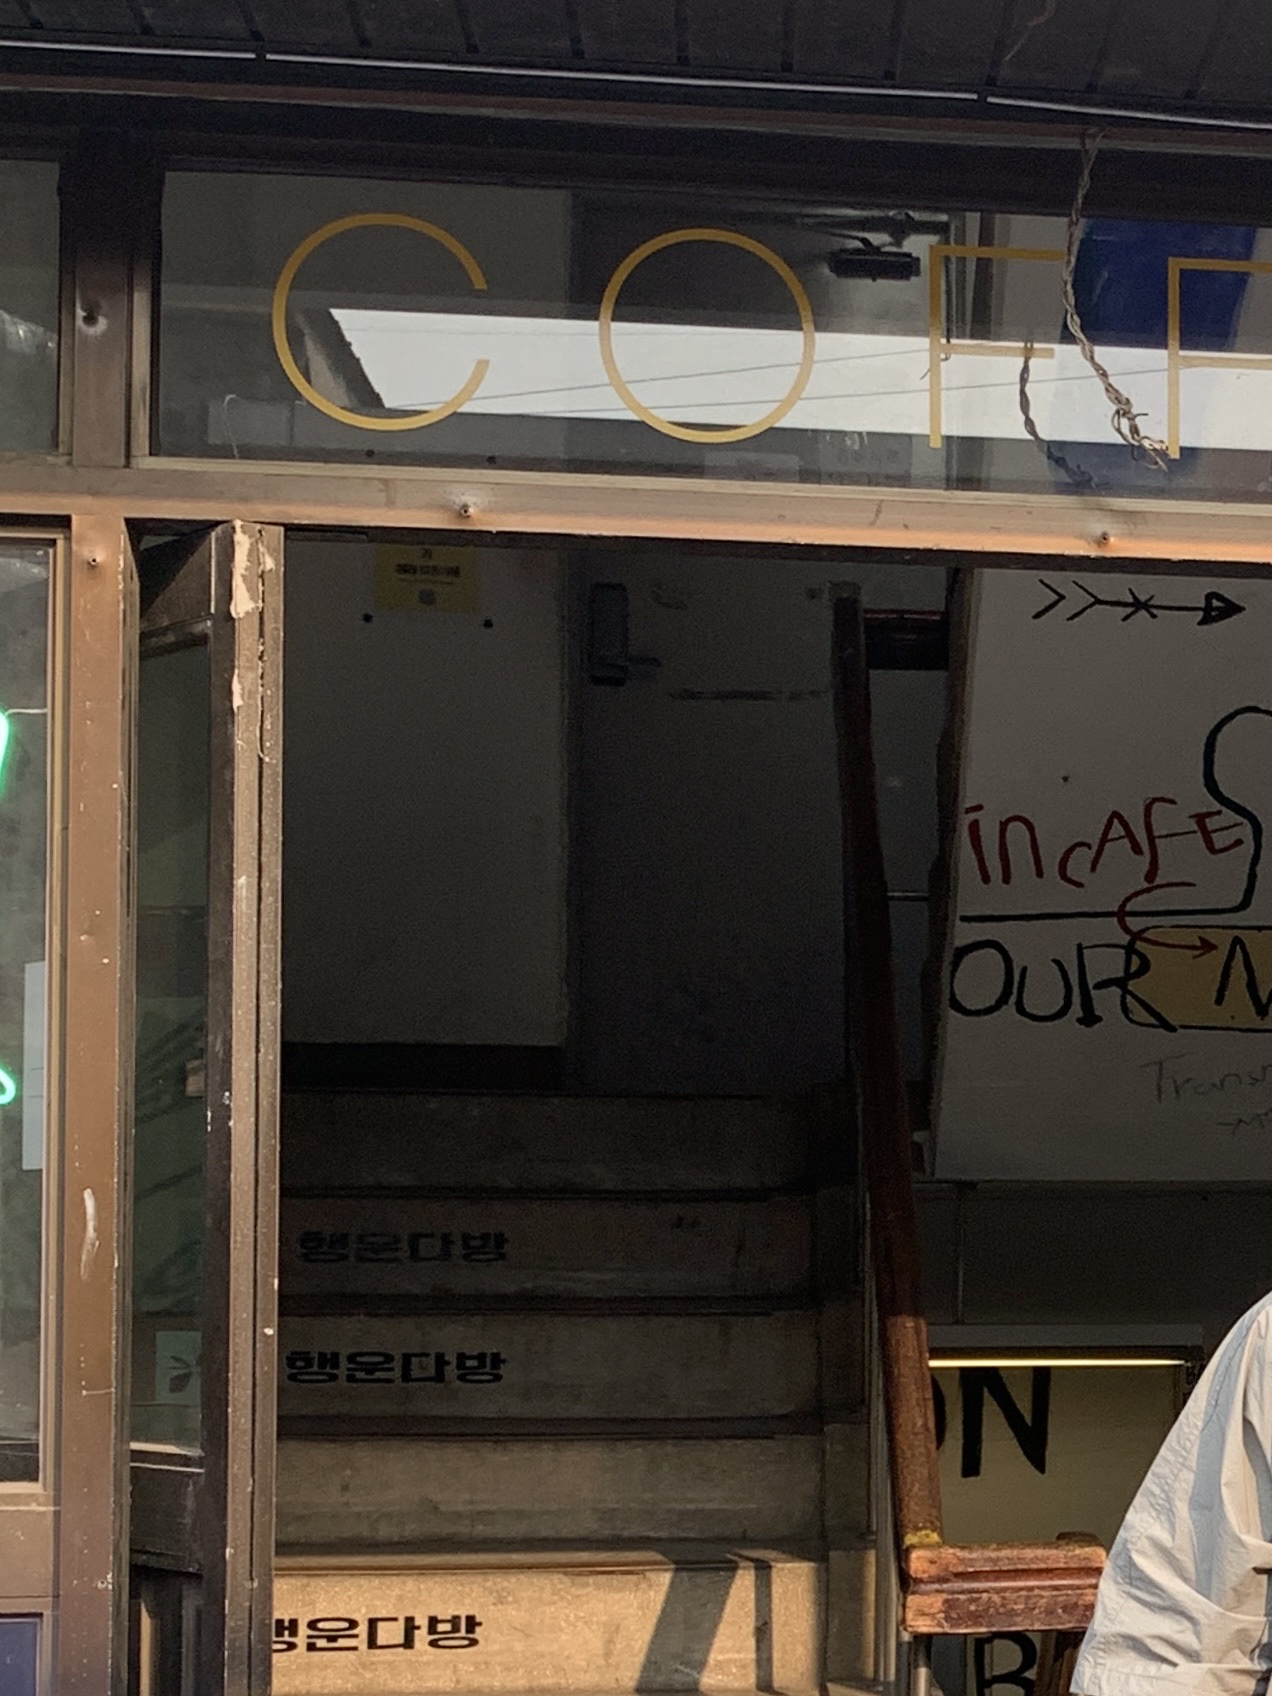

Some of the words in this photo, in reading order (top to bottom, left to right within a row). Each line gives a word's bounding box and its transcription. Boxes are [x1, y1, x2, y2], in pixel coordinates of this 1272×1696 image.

[949, 940, 1178, 1033] OUR
[299, 1231, 509, 1264] 행운다방
[286, 1351, 507, 1384] 행운다방
